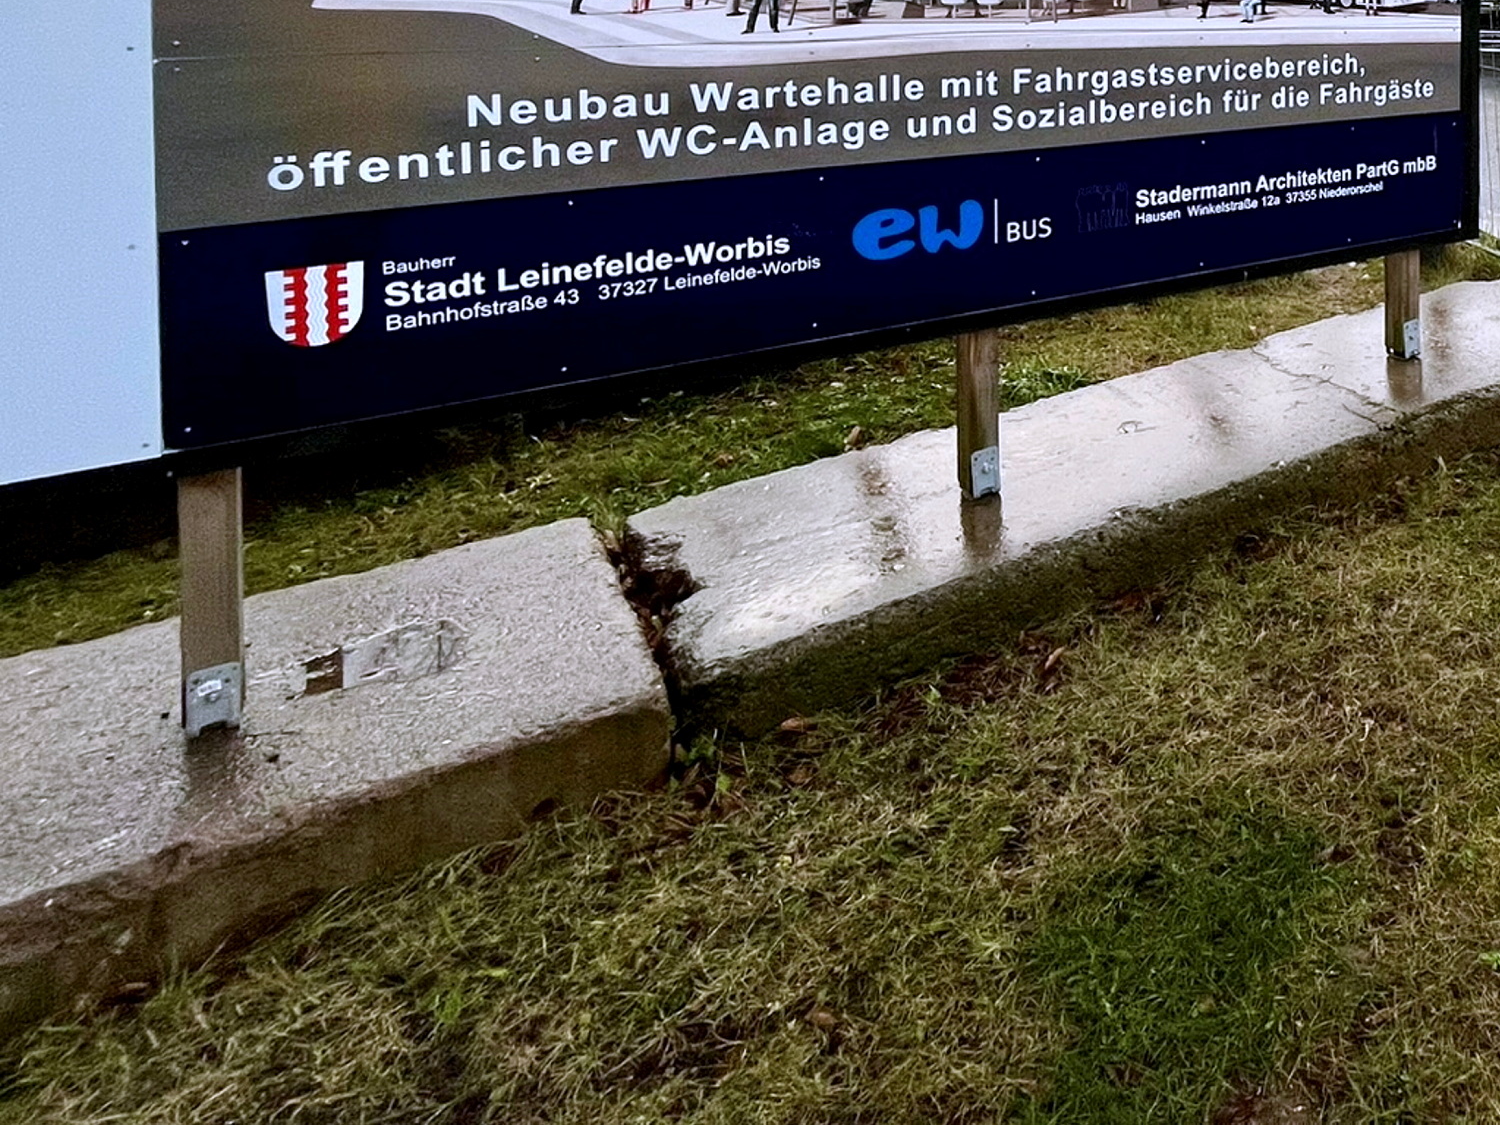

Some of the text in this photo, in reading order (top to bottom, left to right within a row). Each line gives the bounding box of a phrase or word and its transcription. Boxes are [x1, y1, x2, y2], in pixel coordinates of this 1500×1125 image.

[467, 52, 1365, 128] Neubau Wartehalle mit Fahrgastservicebereich,
[267, 78, 1434, 191] öffentlicher WC-Anlage und Sozialbereich für die Fahrgäste
[1135, 154, 1437, 208] Stadermann Architekten PartG mbB
[1135, 180, 1384, 225] Hausen Winkelstraße 12a 37355 Niederorschel
[852, 199, 984, 261] ew
[1006, 216, 1052, 243] BUS
[381, 255, 457, 276] Bauherr
[383, 234, 791, 307] Stadt Leinefelde-Worbis
[385, 255, 821, 332] Bahnhofstraße 43 37327 Leinefelde-Worbis
